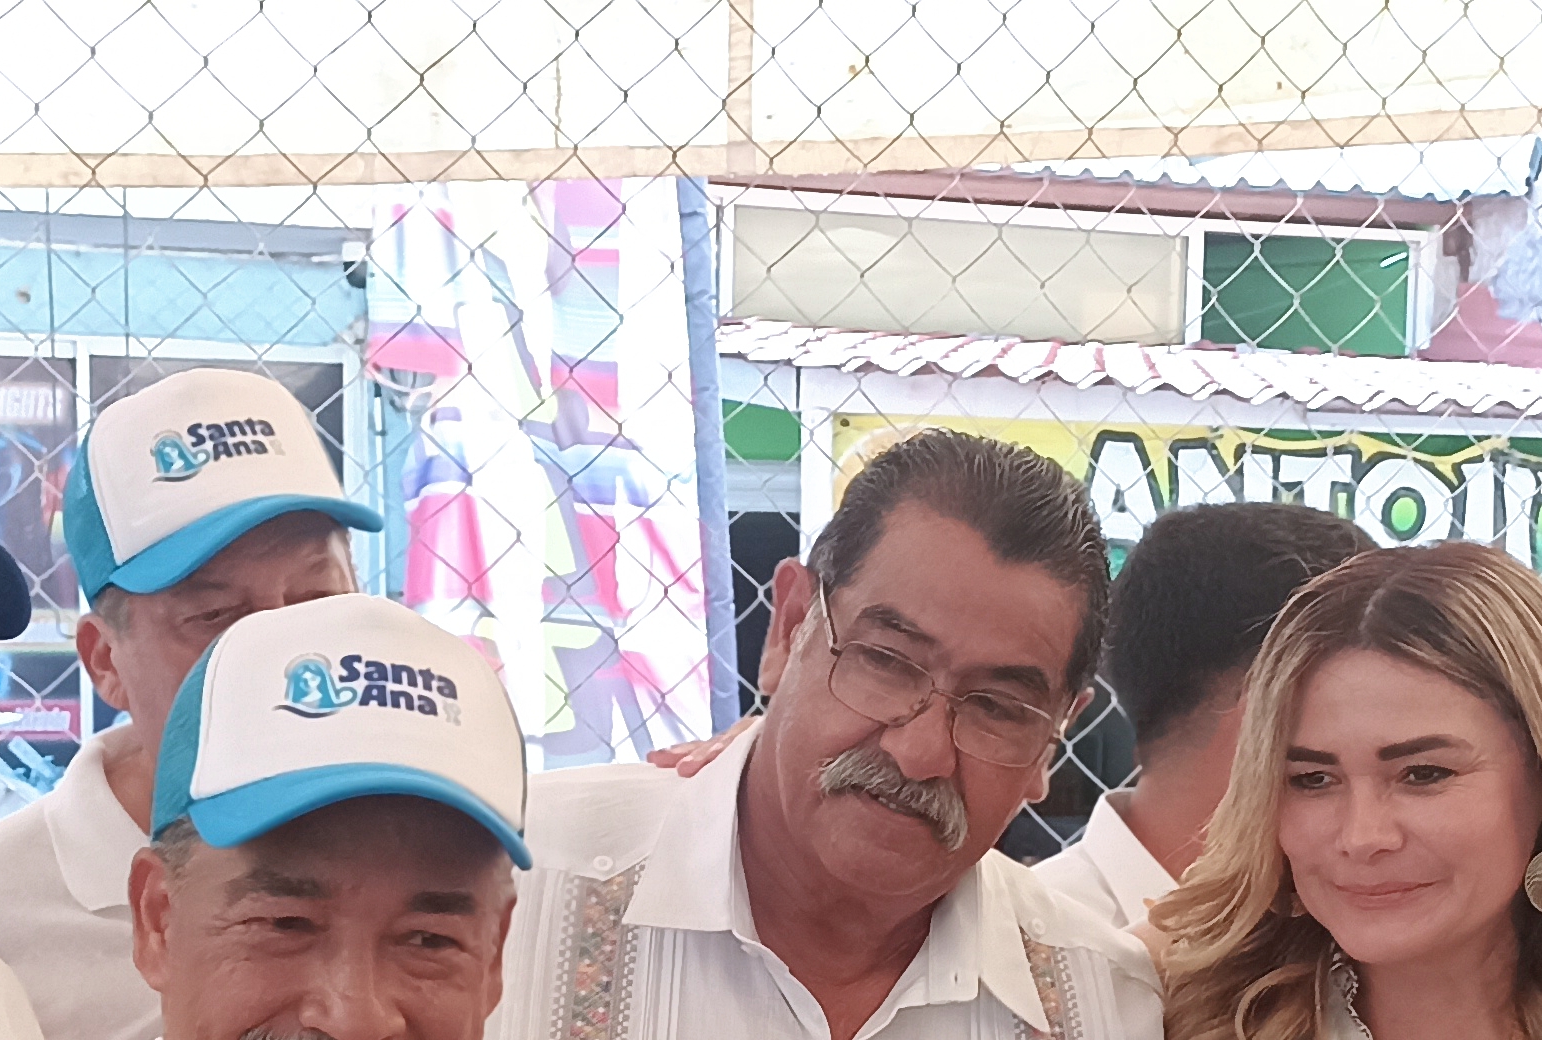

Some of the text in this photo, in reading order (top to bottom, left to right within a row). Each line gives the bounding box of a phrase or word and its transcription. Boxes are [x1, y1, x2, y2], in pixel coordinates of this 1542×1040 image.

[187, 417, 275, 448] Santa
[213, 439, 269, 462] Ana
[338, 654, 458, 700] Santa
[358, 684, 439, 717] Ana
